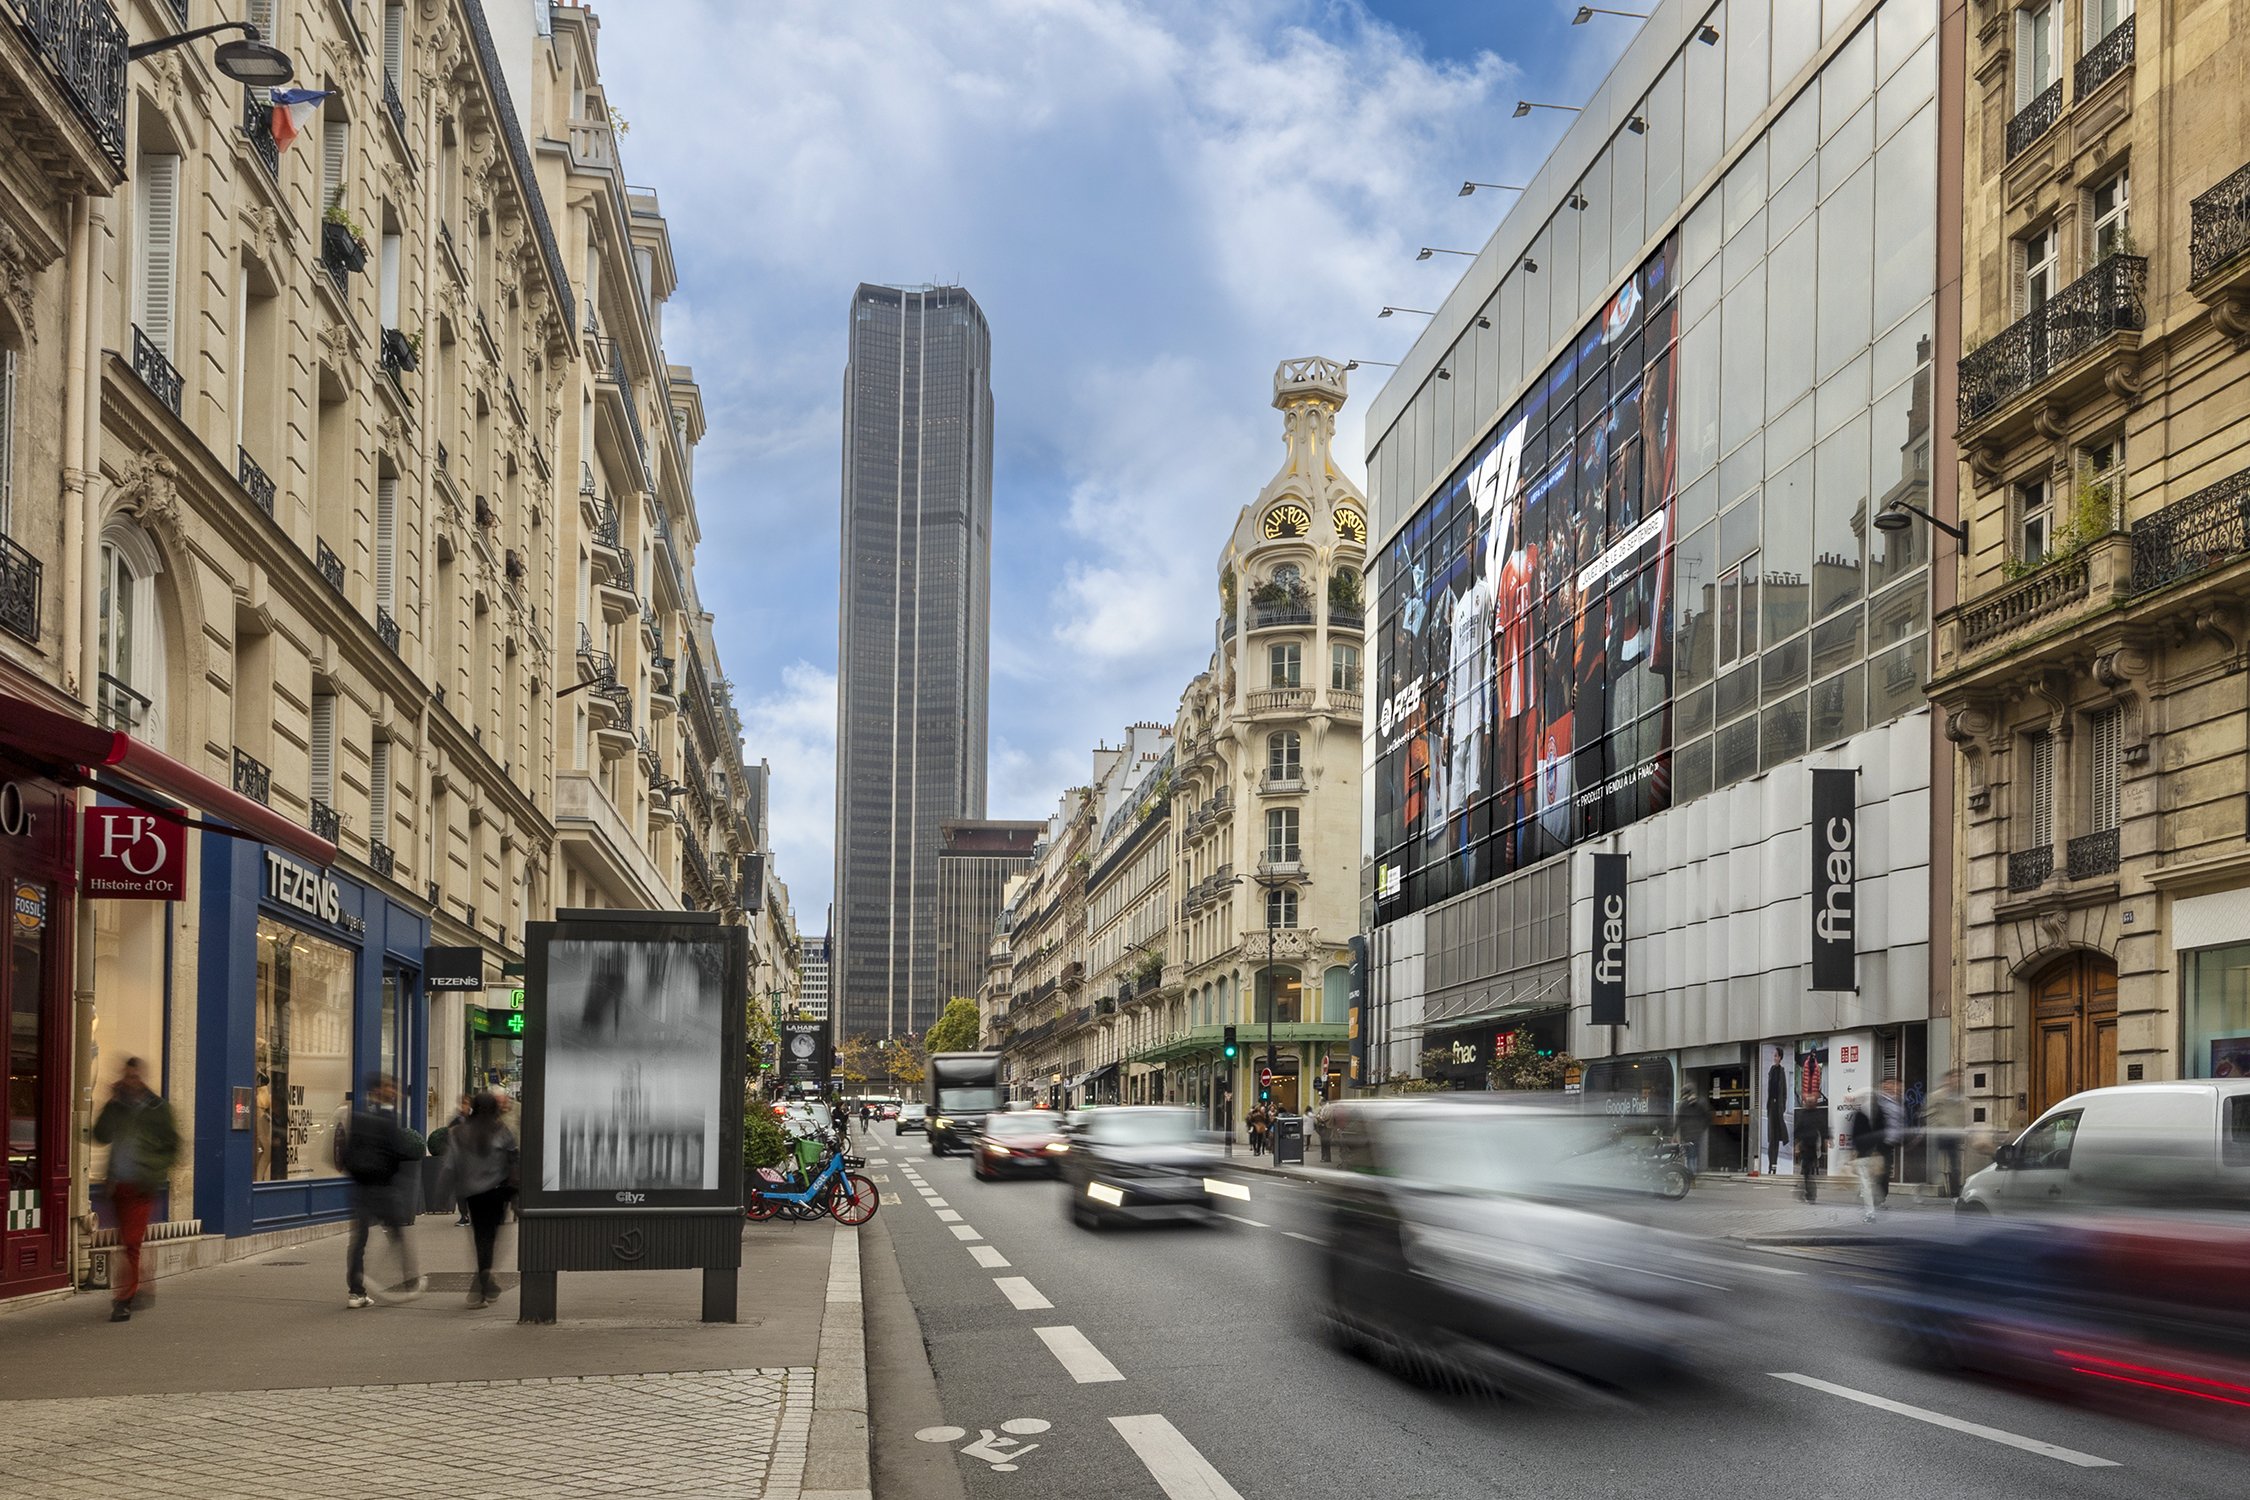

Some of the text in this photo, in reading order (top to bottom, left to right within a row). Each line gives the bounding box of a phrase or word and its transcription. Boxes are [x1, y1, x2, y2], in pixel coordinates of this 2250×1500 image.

[1610, 549, 1617, 563] LE
[1618, 542, 1626, 558] 26
[1626, 516, 1660, 552] SEPTEMBRE
[1605, 774, 1624, 795] VENDU
[1629, 771, 1637, 785] LA
[90, 878, 174, 892] Histoire d'Or
[267, 849, 339, 925] TEZENIS
[1816, 817, 1851, 944] fnac
[15, 896, 42, 917] FOSSIL
[1595, 894, 1623, 985] fnac
[430, 976, 479, 986] TEZENIS
[1452, 1040, 1477, 1064] fnac
[1605, 1097, 1649, 1118] Google Pixel
[813, 1174, 828, 1190] dott
[615, 1191, 645, 1204] Cityz
